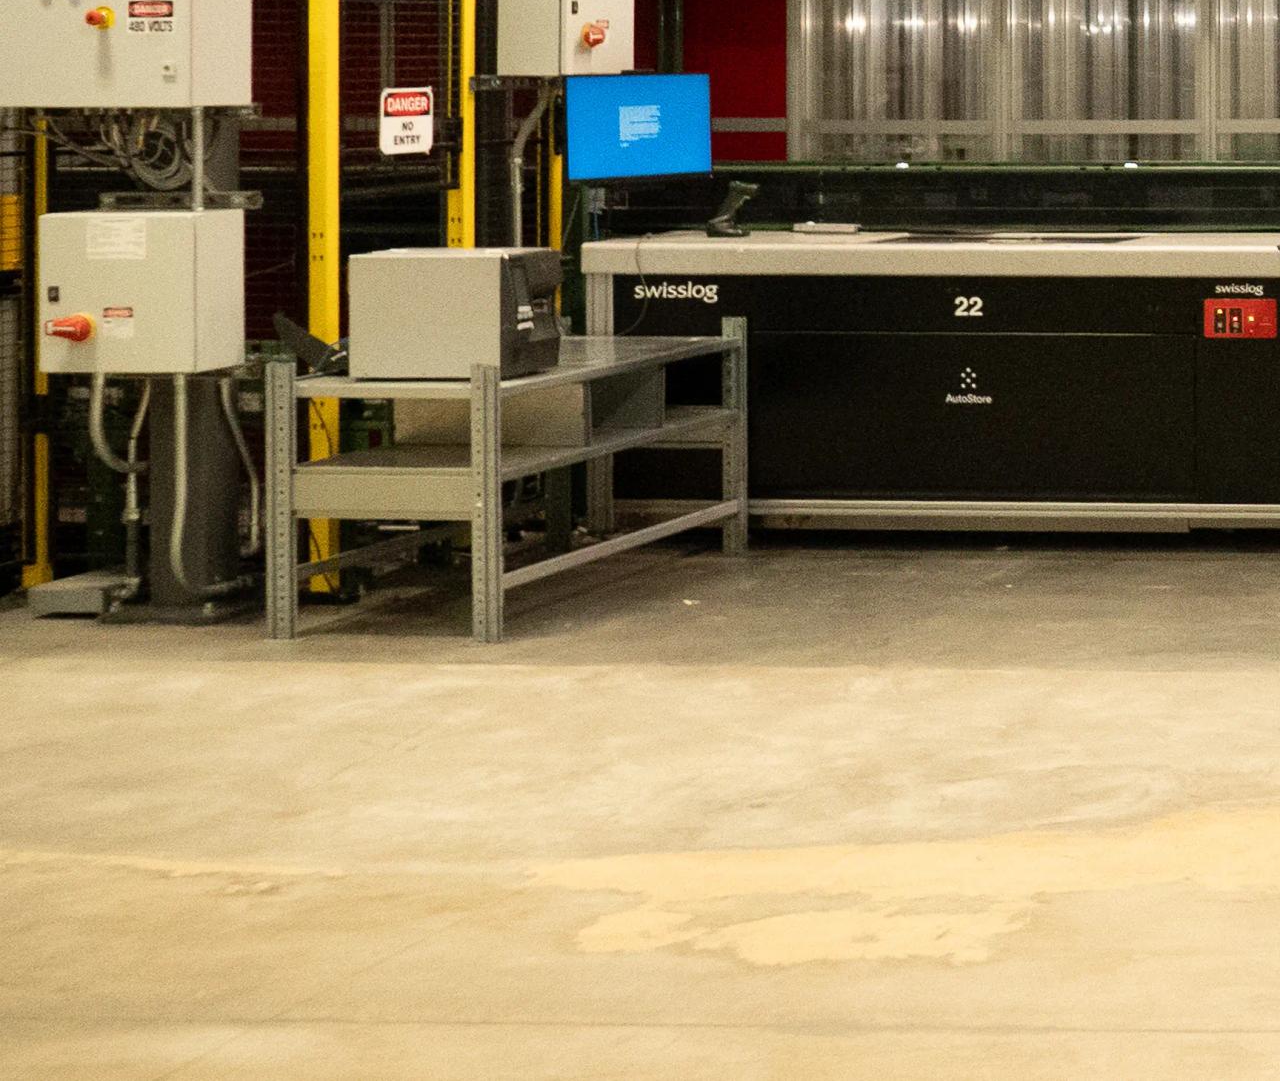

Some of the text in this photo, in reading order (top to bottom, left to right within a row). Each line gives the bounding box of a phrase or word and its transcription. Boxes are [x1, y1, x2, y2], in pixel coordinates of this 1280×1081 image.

[148, 20, 173, 32] VOLTS
[387, 96, 429, 113] DANGER
[402, 120, 414, 131] NO
[394, 135, 421, 146] ENTRY
[633, 281, 719, 304] swisslog
[1215, 283, 1264, 296] swisslog
[954, 296, 984, 317] 22
[945, 393, 993, 405] AutoStore
